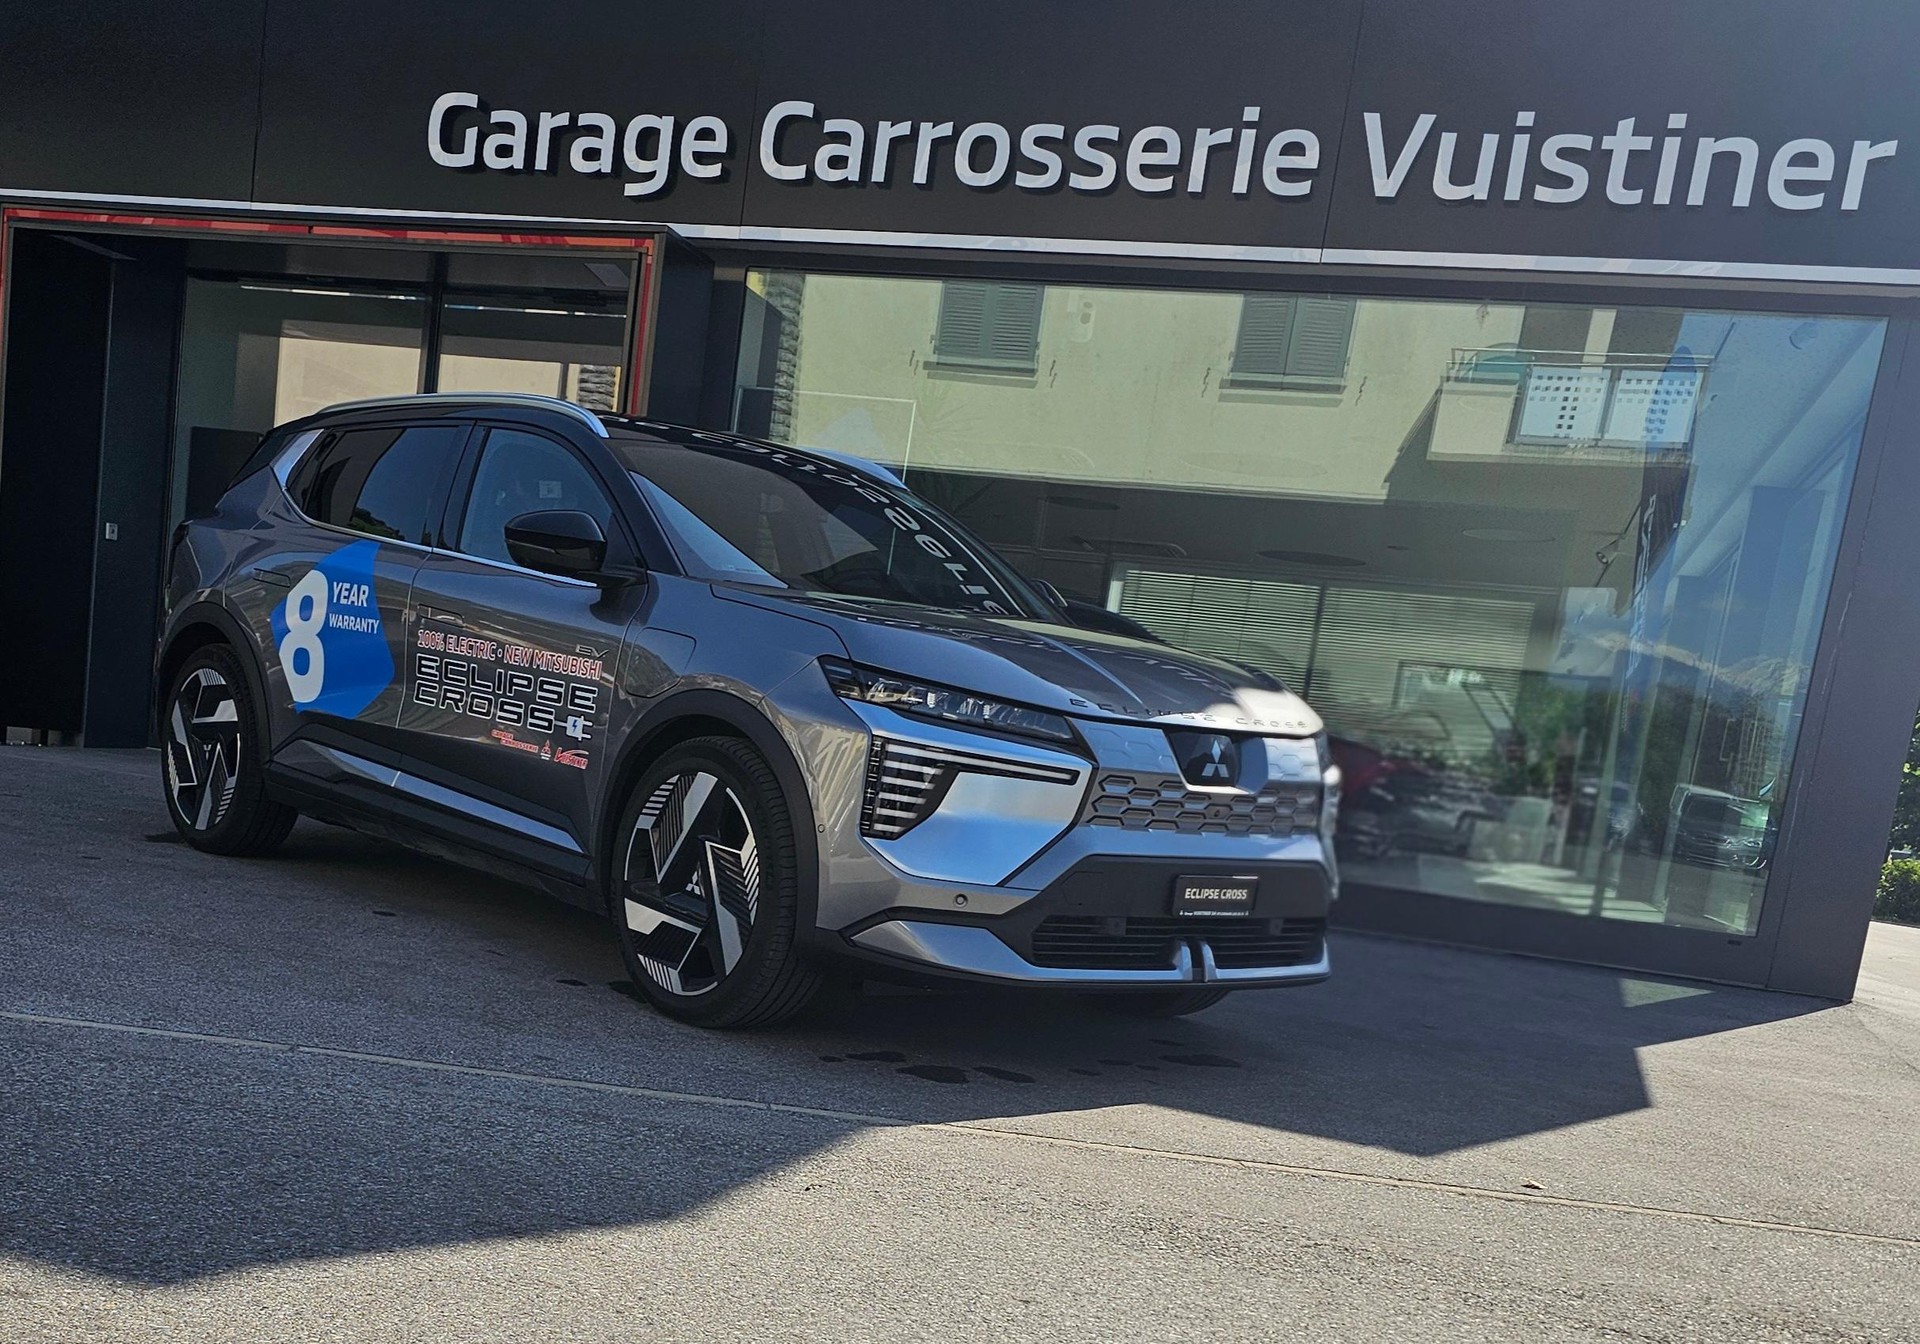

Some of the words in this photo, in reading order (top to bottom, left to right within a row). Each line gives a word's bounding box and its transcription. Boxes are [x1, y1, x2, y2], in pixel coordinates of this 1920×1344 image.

[428, 92, 728, 197] Garage
[759, 100, 1320, 196] Carrosserie
[1363, 111, 1898, 211] Vuistiner
[332, 582, 369, 606] YEAR
[279, 569, 328, 703] 8
[329, 613, 379, 634] WARRANTY
[417, 629, 445, 652] 100%
[446, 634, 496, 660] ELECTRIC
[504, 644, 535, 668] NEW
[533, 650, 603, 681] MITSUBISHI
[414, 680, 554, 733] CROSS
[416, 653, 599, 714] ECLIPSE
[1184, 888, 1220, 899] ECLIPSE
[1220, 888, 1248, 900] CROSS
